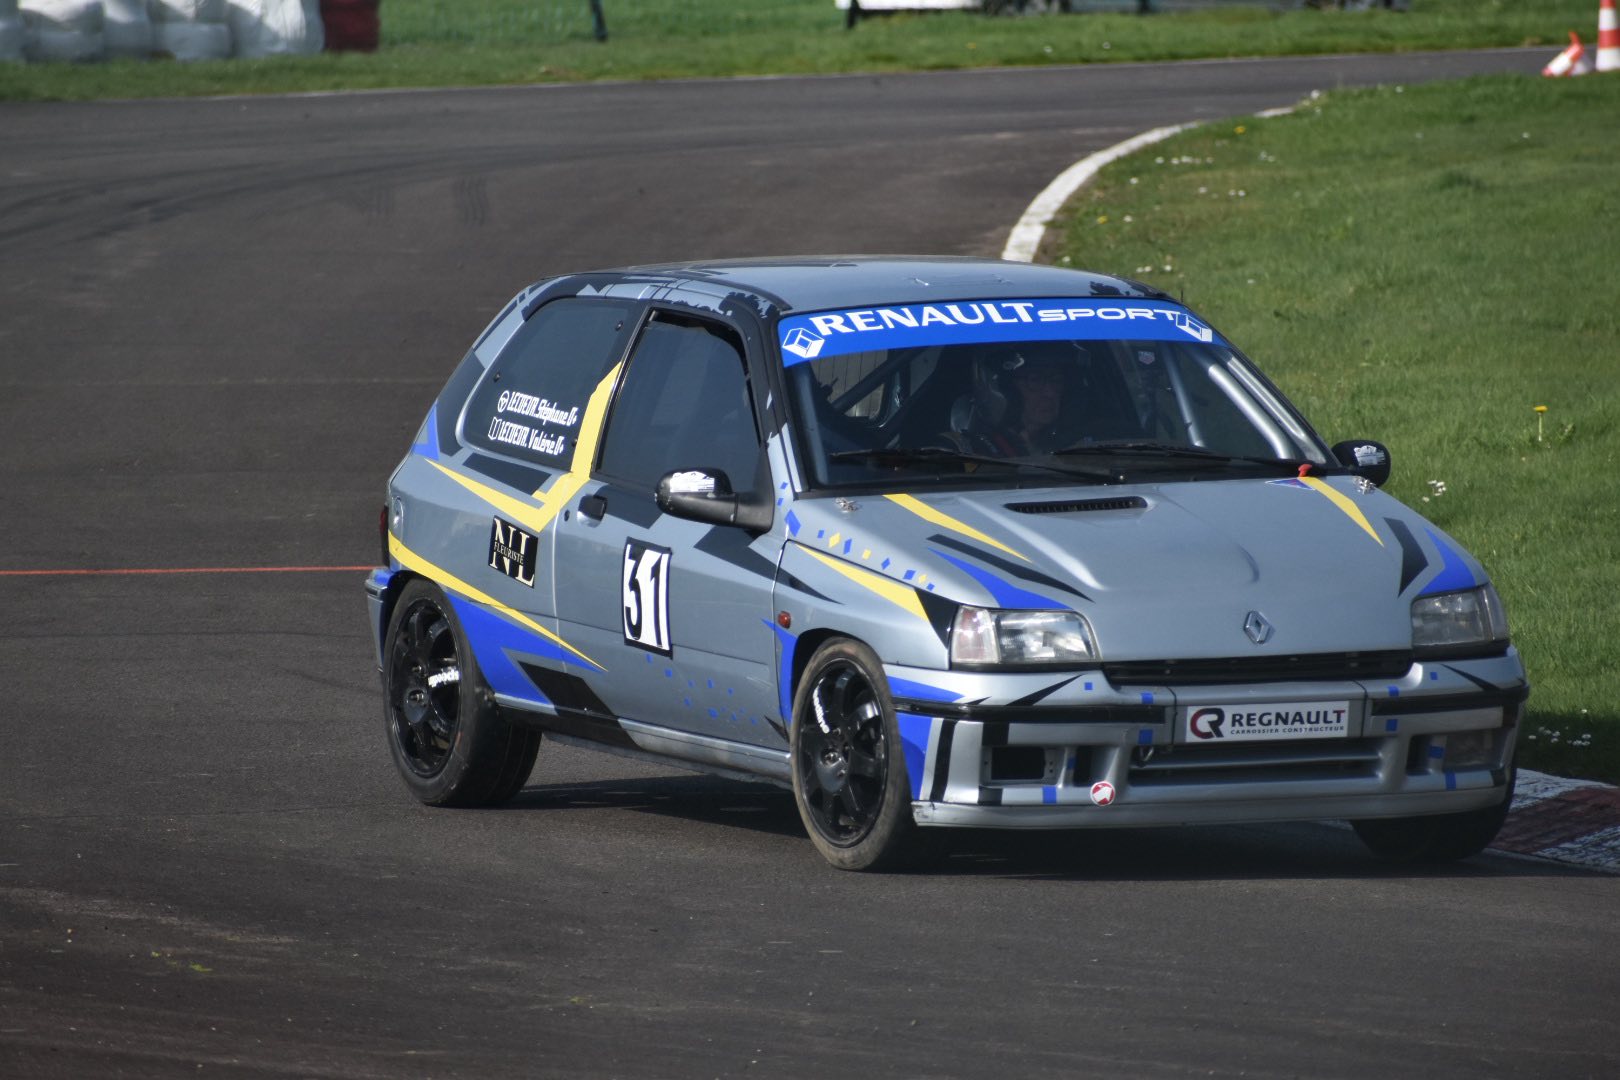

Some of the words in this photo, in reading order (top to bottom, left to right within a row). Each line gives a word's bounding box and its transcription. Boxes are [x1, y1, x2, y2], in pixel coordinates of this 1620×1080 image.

[808, 302, 1035, 337] RENAULT
[1037, 307, 1181, 322] SPORT
[493, 541, 524, 565] FLEURISTE
[624, 545, 663, 649] 31
[1230, 709, 1346, 728] REGNAULT
[1282, 726, 1345, 734] CONSTRUCTEUR
